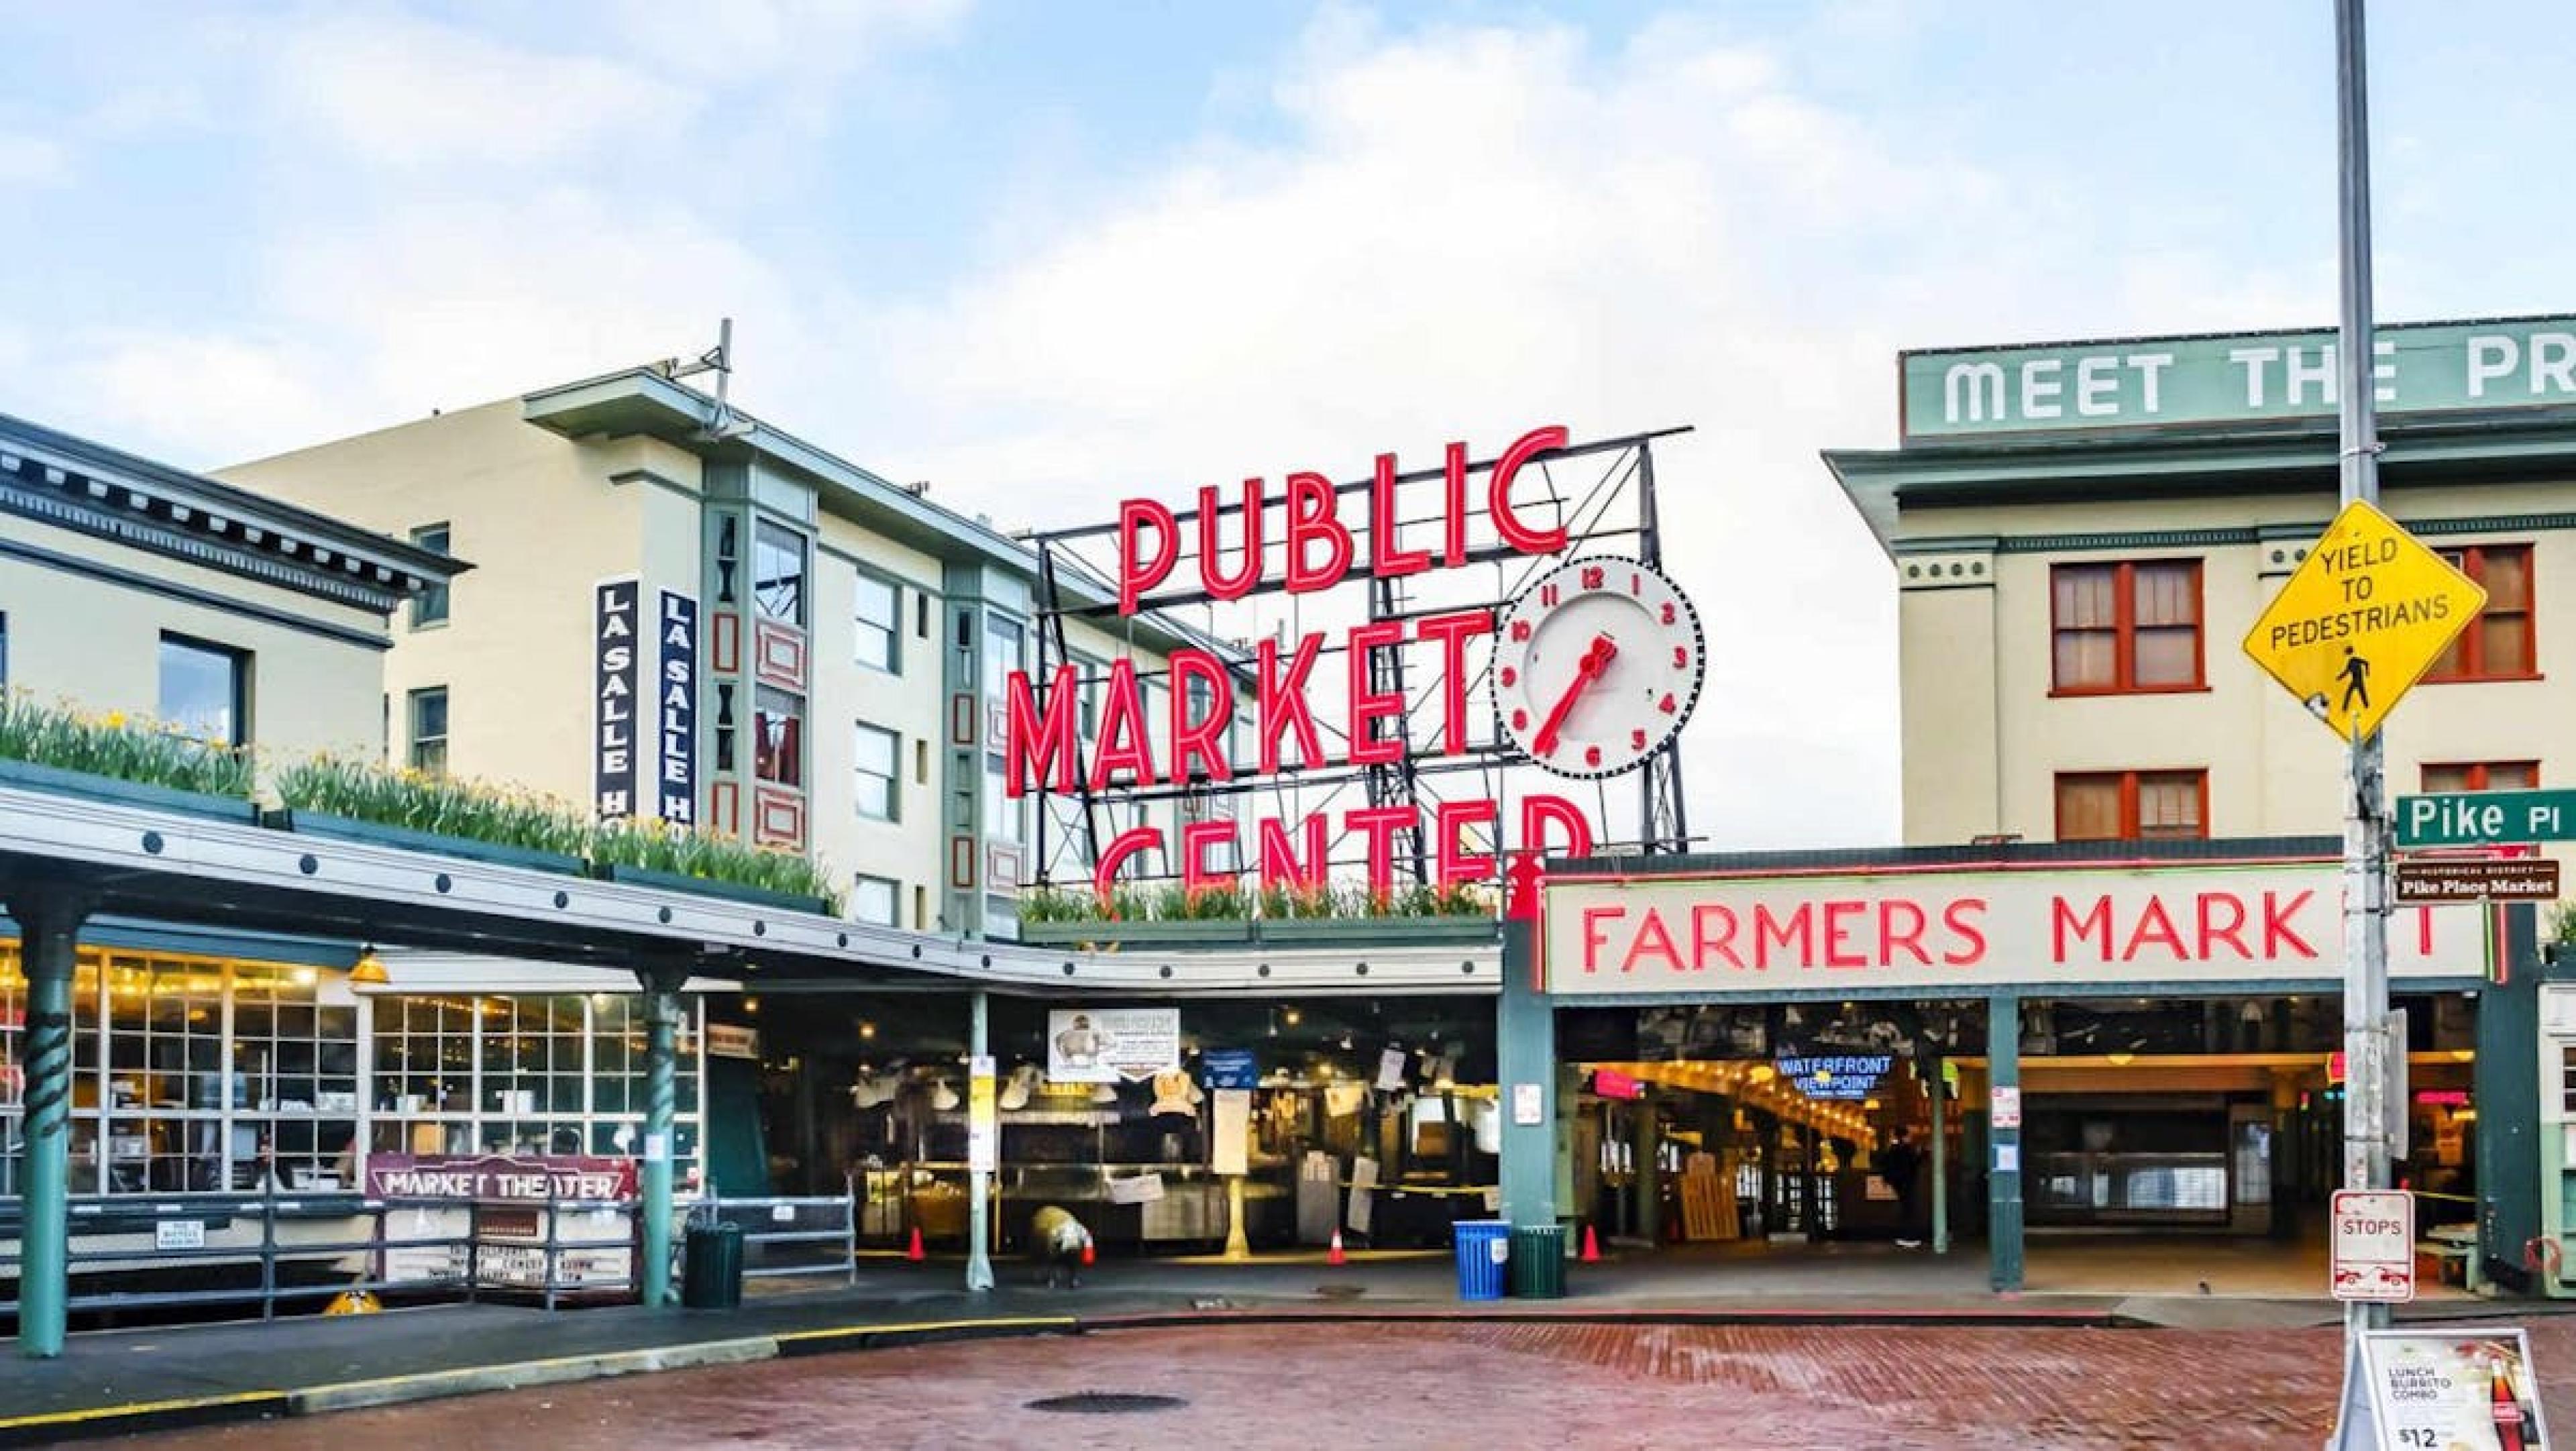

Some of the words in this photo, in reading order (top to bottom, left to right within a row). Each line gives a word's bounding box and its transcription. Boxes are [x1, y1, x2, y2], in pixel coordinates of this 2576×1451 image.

[1945, 354, 2174, 423] MEET
[1119, 425, 1569, 616] PUBLIC
[2321, 538, 2398, 575] YIELD
[1582, 566, 1604, 590] 12
[1631, 573, 1641, 596] 1
[2341, 576, 2373, 603] TO
[1542, 584, 1558, 607] 11
[601, 590, 631, 638] LA
[665, 596, 692, 649] LA
[1662, 602, 1675, 625] 2
[2271, 594, 2449, 651] PEDESTRIANS
[1511, 620, 1532, 643] 10
[1672, 645, 1688, 669] 3
[1501, 665, 1517, 688] 9
[601, 646, 631, 774] SALLE
[1006, 609, 1496, 798] MARKET
[1658, 692, 1676, 715] 4
[665, 657, 690, 784] SALLE
[1512, 708, 1528, 731] 8
[1631, 729, 1646, 751] 5
[1586, 745, 1601, 767] 6
[2410, 798, 2504, 838] Pike
[2528, 806, 2560, 833] Pl
[2402, 879, 2439, 894] Pike
[2442, 879, 2489, 894] Place
[2489, 879, 2554, 894] Market
[1583, 898, 1987, 973] FARMERS
[2052, 890, 2432, 963] MARK
[1779, 1056, 1892, 1075] WATERFRONT
[386, 1173, 488, 1196] MARKET
[2344, 1218, 2402, 1236] STOPS
[2389, 1366, 2435, 1377] LUNCH
[2391, 1377, 2452, 1389] BURRITO
[2393, 1389, 2437, 1400] COMBO
[2398, 1427, 2439, 1448] $12
